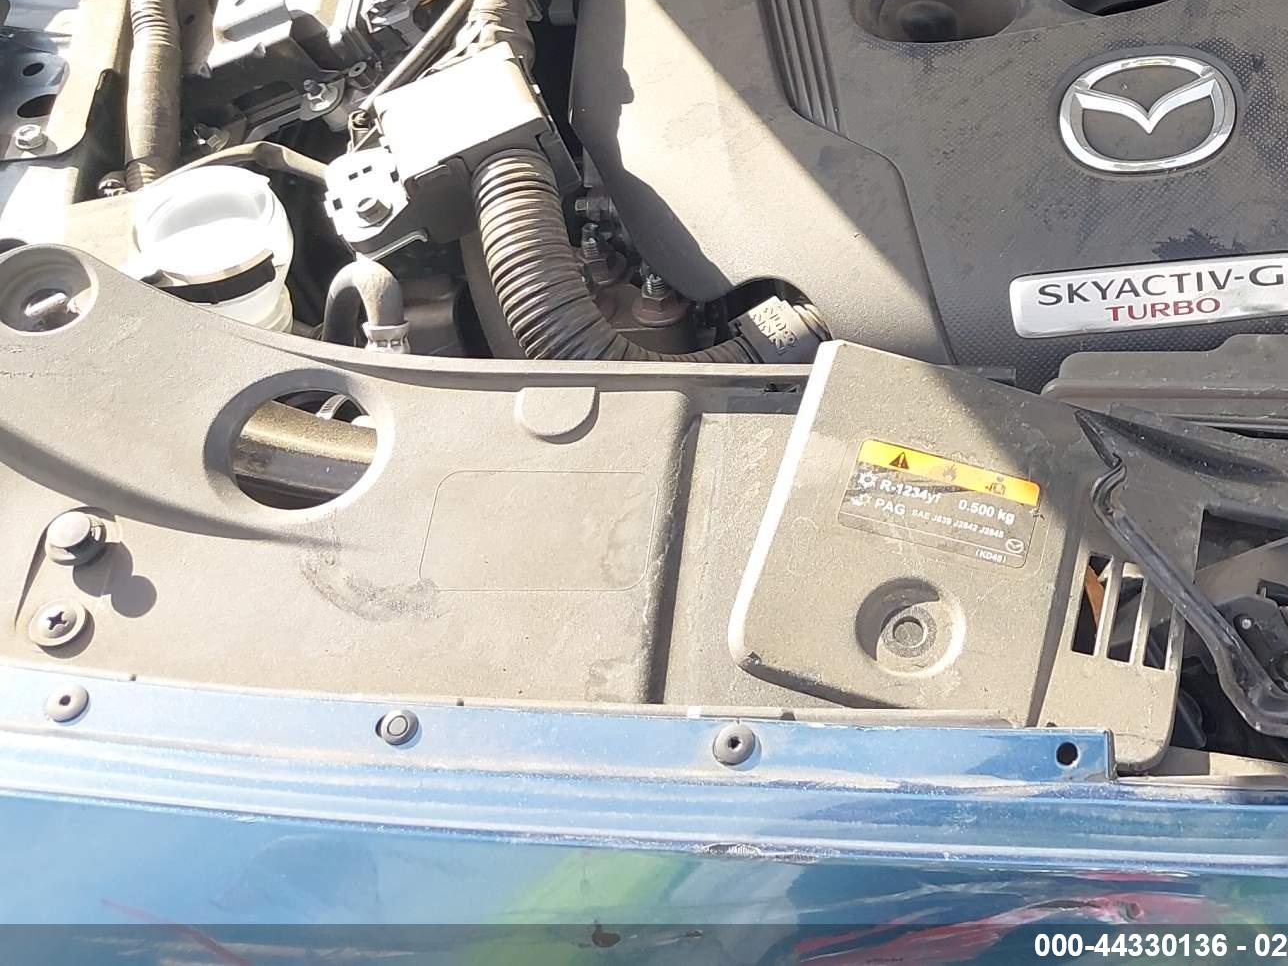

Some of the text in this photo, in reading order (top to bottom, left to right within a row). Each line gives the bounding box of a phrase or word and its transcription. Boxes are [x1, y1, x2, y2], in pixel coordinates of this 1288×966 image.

[1037, 264, 1285, 307] SKYACTIV-G
[1105, 297, 1221, 322] TURBO
[874, 498, 906, 516] PAG
[911, 509, 930, 520] SAE
[879, 479, 1016, 525] R-1234yf 0.500 kg
